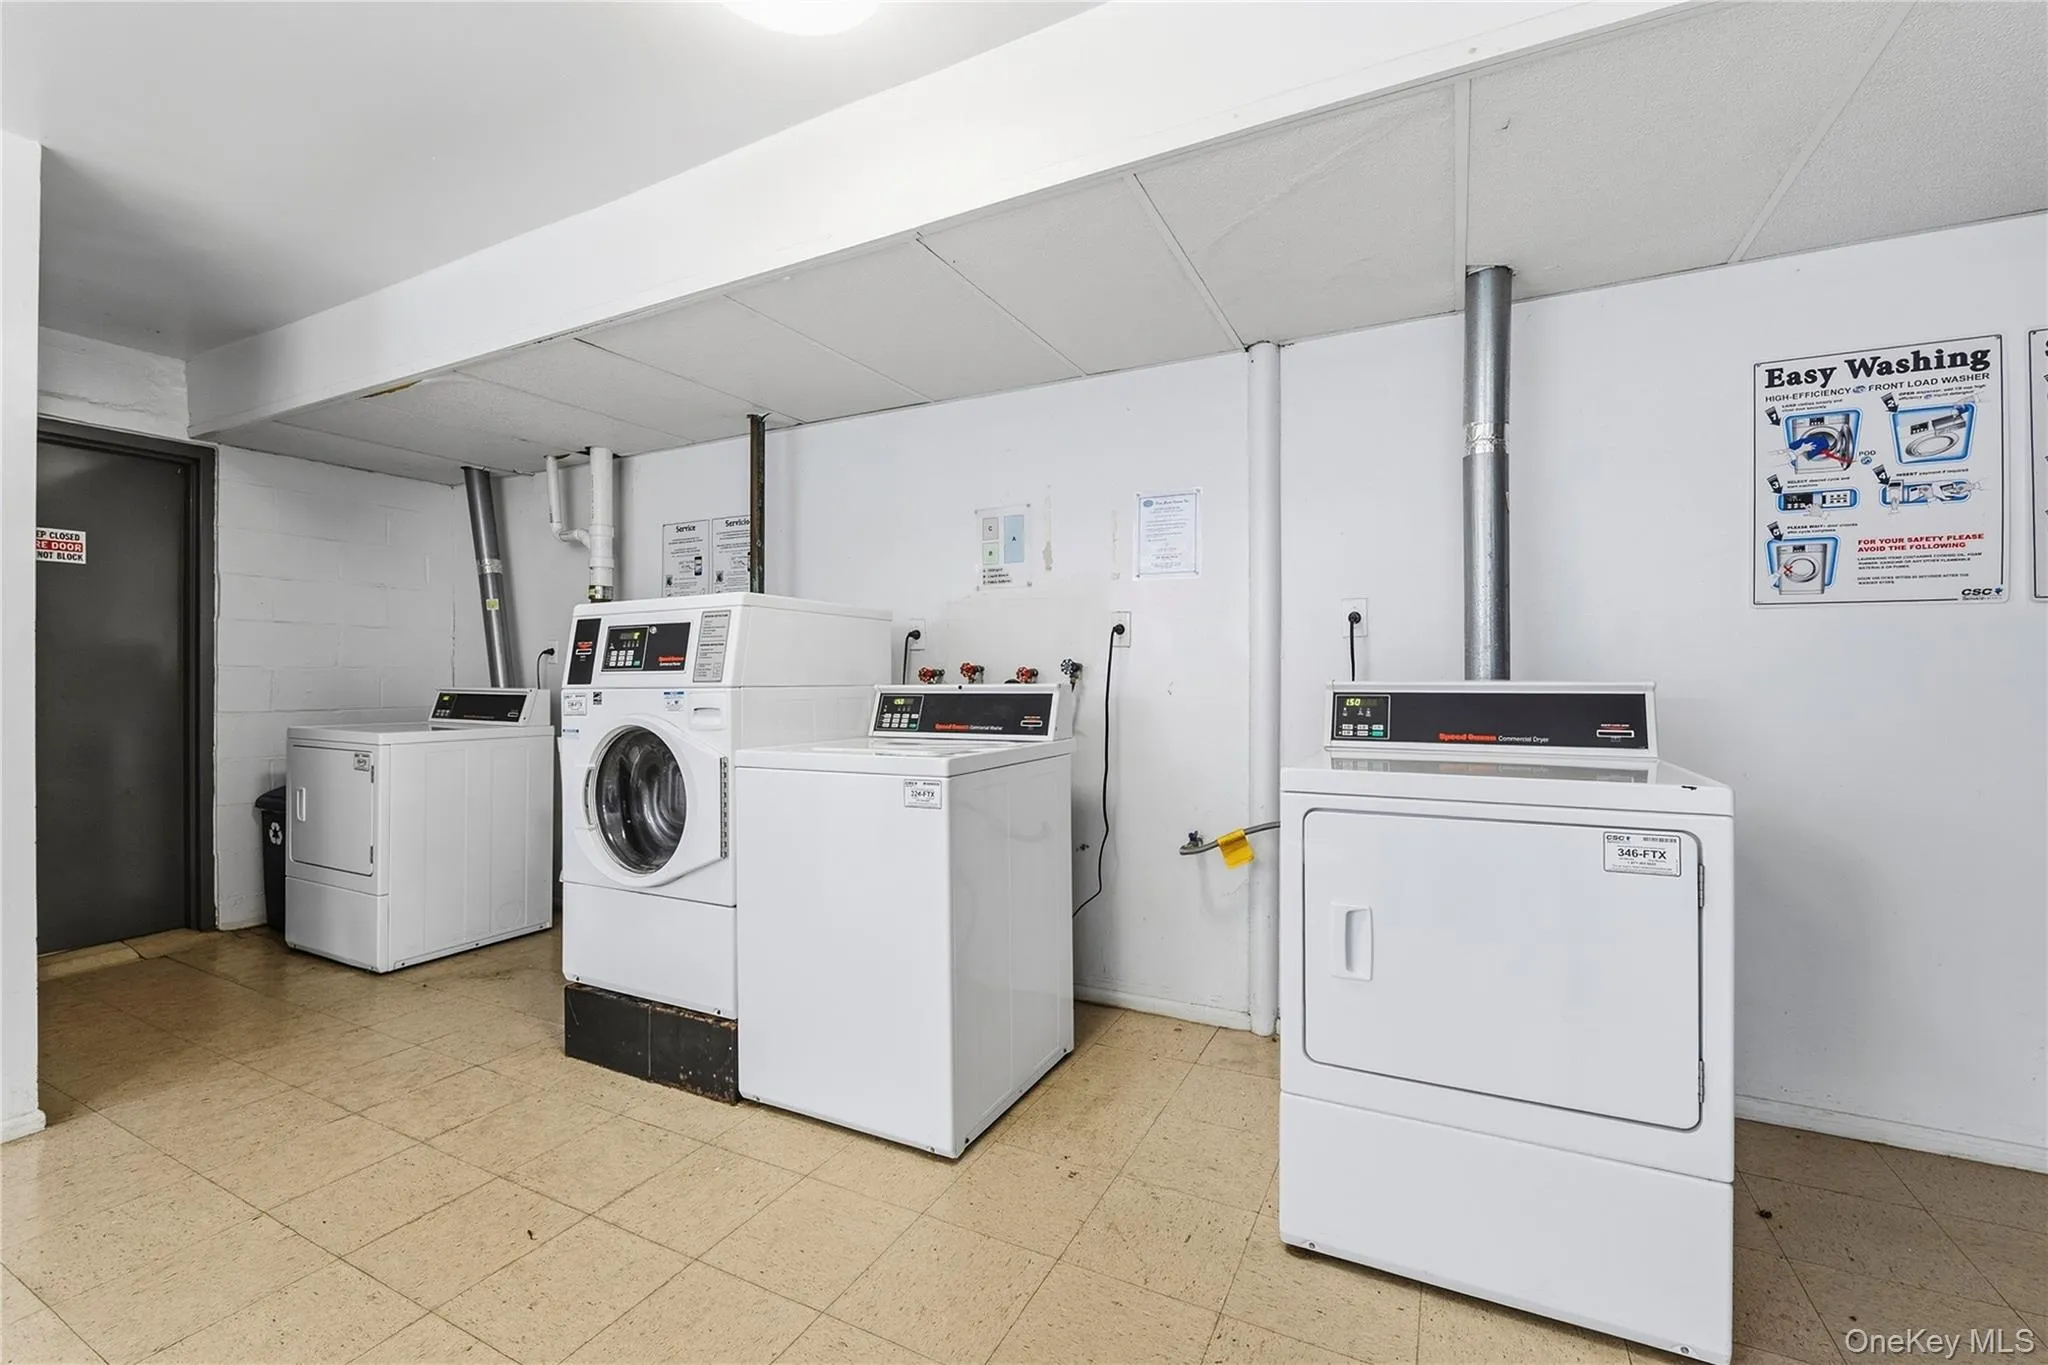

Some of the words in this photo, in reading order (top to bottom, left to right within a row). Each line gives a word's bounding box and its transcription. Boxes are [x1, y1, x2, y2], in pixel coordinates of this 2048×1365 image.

[1764, 367, 1837, 388] Easy
[1844, 348, 1991, 378] Washing
[1765, 388, 1851, 402] HIGH-EFFICIENCY
[1868, 382, 1905, 392] FRONT
[1908, 378, 1938, 388] LOAD
[1941, 372, 1990, 384] WASHER
[676, 525, 696, 533] Service
[49, 531, 80, 541] CLOSED
[51, 542, 82, 552] DOOR
[1910, 542, 1966, 550] FOLLOWING
[57, 552, 83, 561] BLOCK
[1962, 588, 1992, 596] CSC
[1439, 733, 1467, 741] Speed
[1618, 848, 1667, 860] 346-FTX
